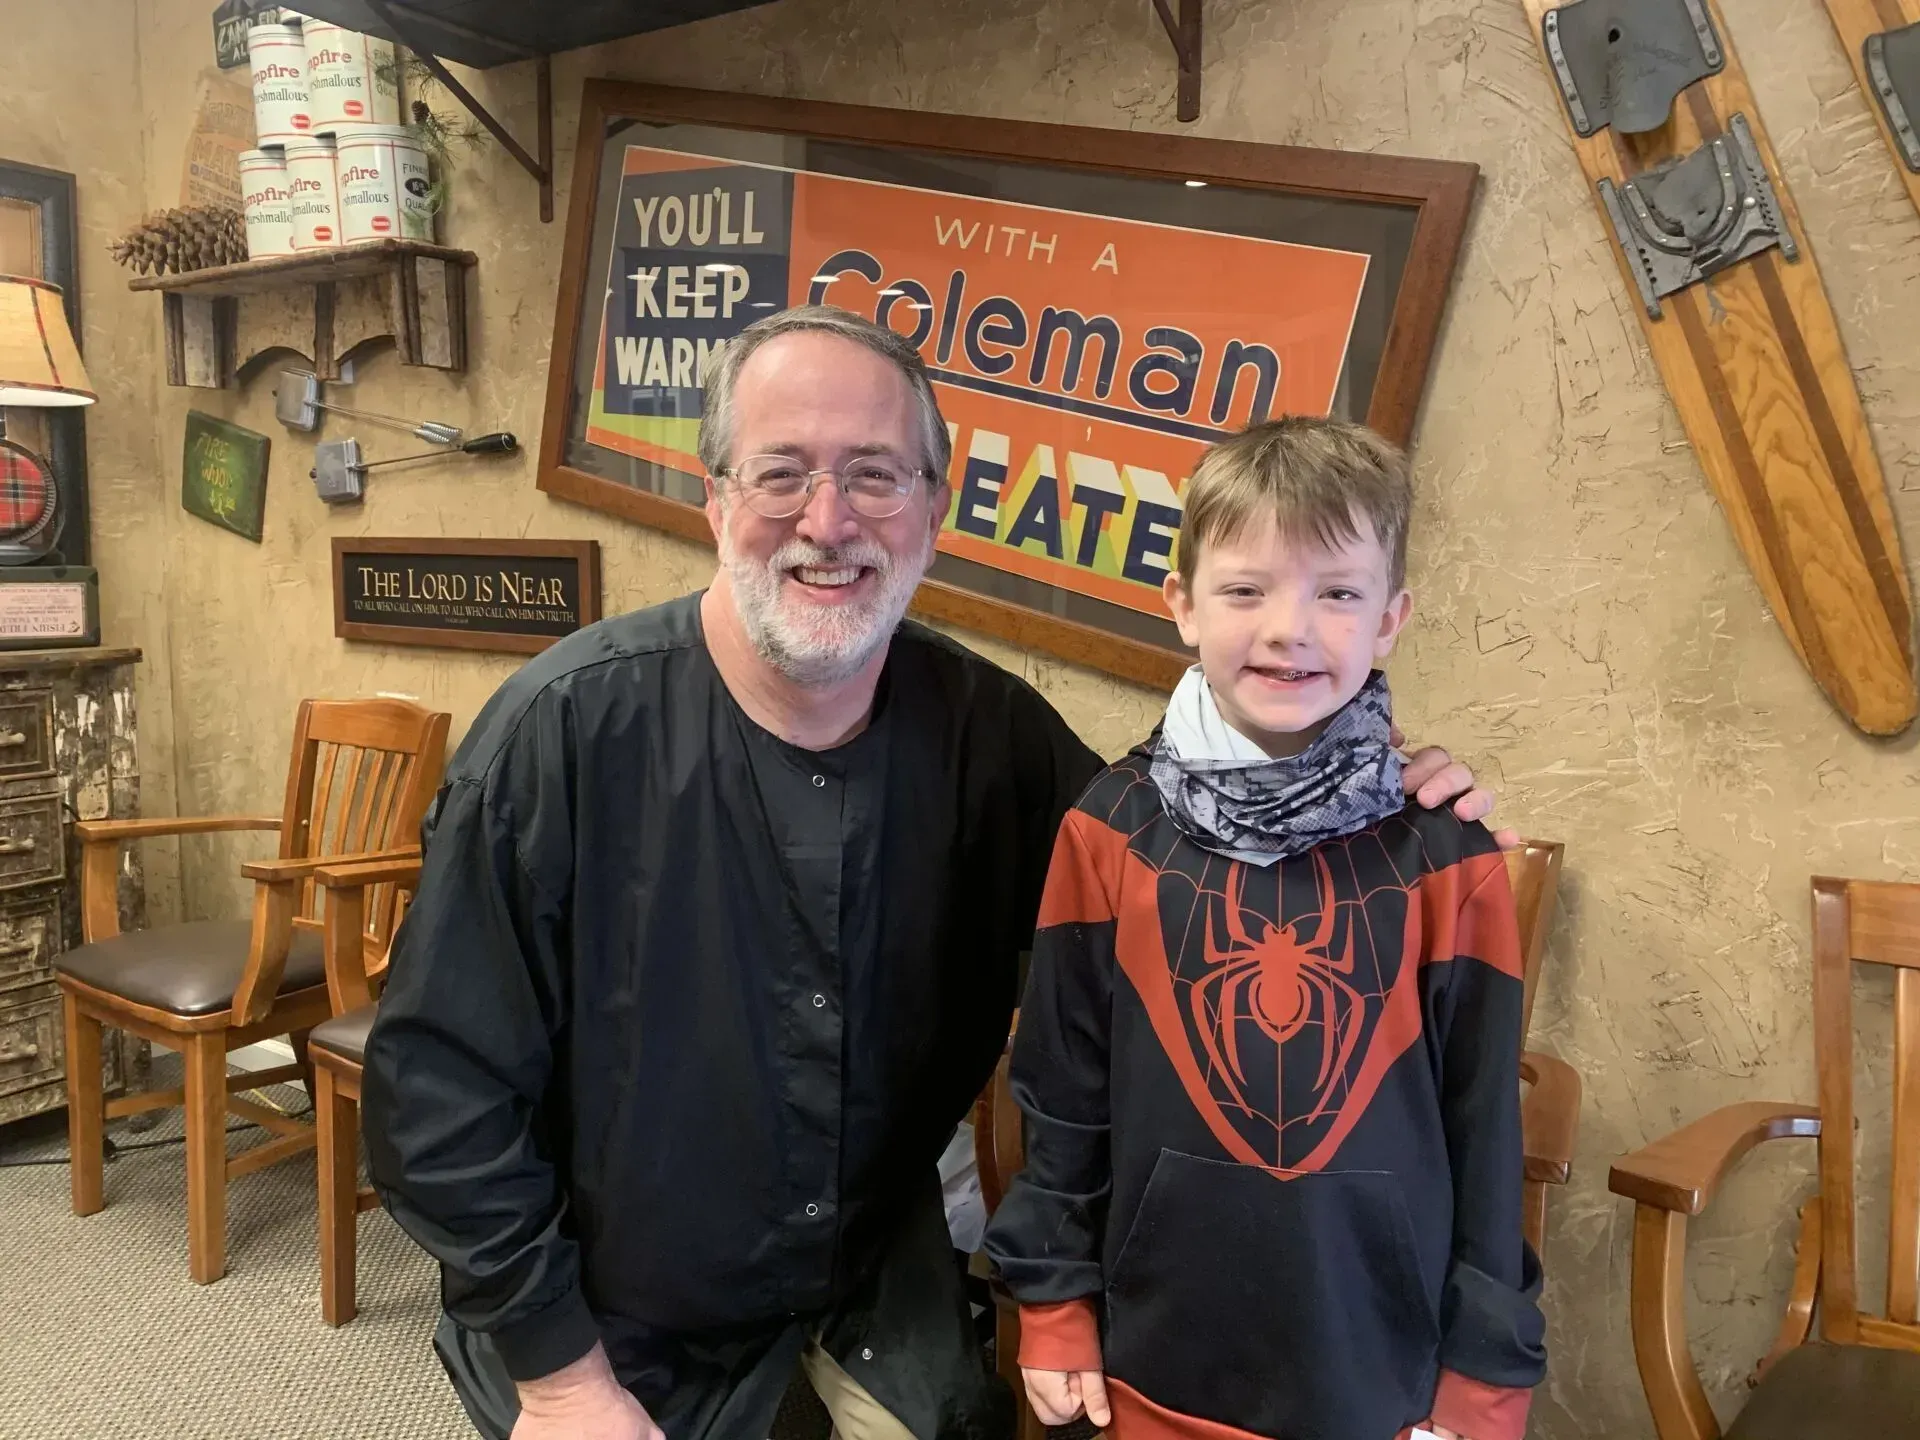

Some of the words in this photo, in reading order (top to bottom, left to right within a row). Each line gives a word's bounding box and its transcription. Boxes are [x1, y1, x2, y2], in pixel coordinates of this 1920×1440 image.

[233, 44, 247, 61] AL
[402, 162, 427, 175] FINE
[404, 197, 428, 211] QUAL
[633, 186, 765, 248] YOU'LL
[934, 214, 1059, 264] WITH
[1091, 242, 1120, 275] A
[635, 263, 751, 319] KEEP
[807, 248, 1282, 426] Coleman
[944, 422, 1186, 588] EATE
[364, 600, 376, 611] ALL
[376, 601, 394, 612] WHO
[394, 602, 410, 613] CALL
[440, 604, 451, 615] TO
[451, 605, 465, 616] ALL
[465, 605, 484, 617] WHO
[485, 607, 504, 618] CALL
[505, 607, 518, 619] ON
[519, 608, 535, 620] HIM
